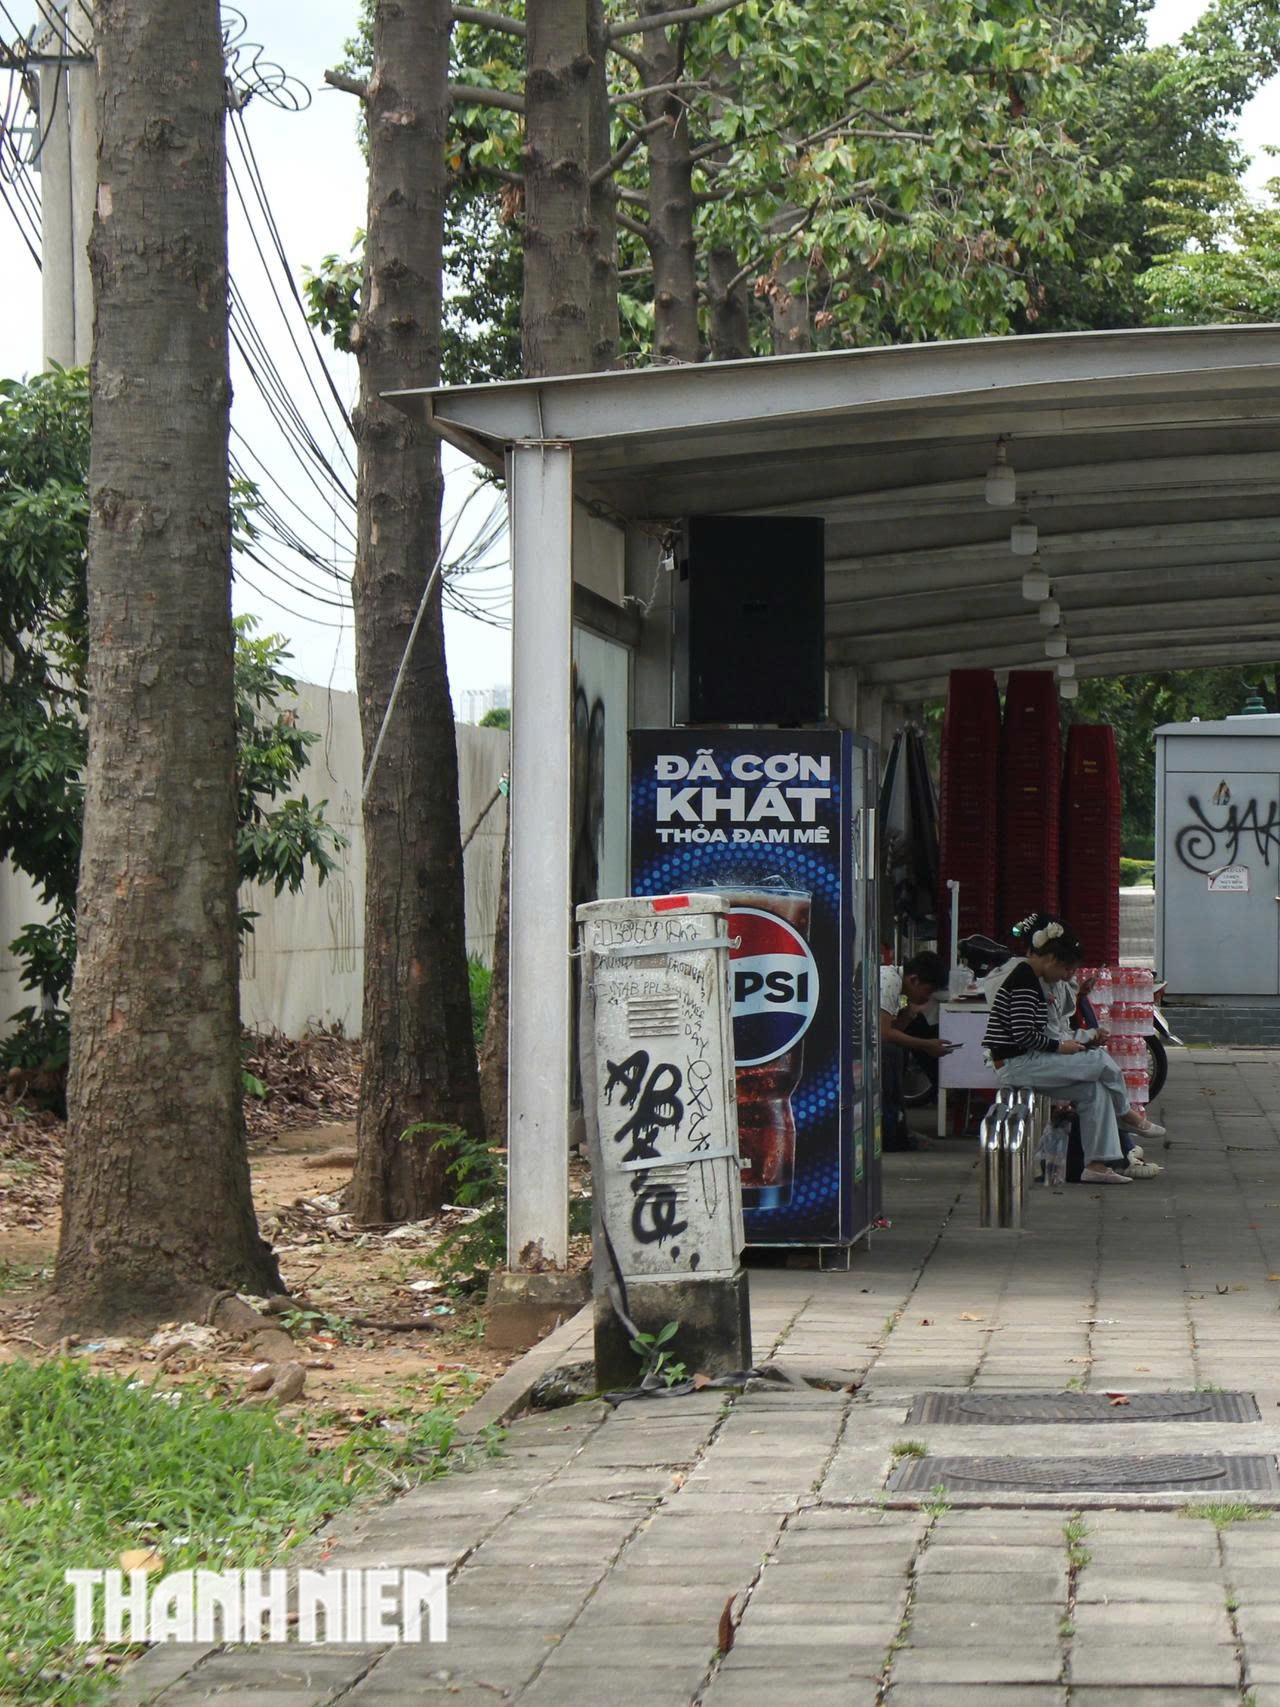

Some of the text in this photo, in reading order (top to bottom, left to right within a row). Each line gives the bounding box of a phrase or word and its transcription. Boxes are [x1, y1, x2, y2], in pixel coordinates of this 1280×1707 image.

[654, 749, 831, 781] ĐÃ CƠN
[656, 782, 831, 822] KHÁT
[656, 824, 830, 843] THỎA ĐAM MÊ
[734, 971, 809, 1003] PSI
